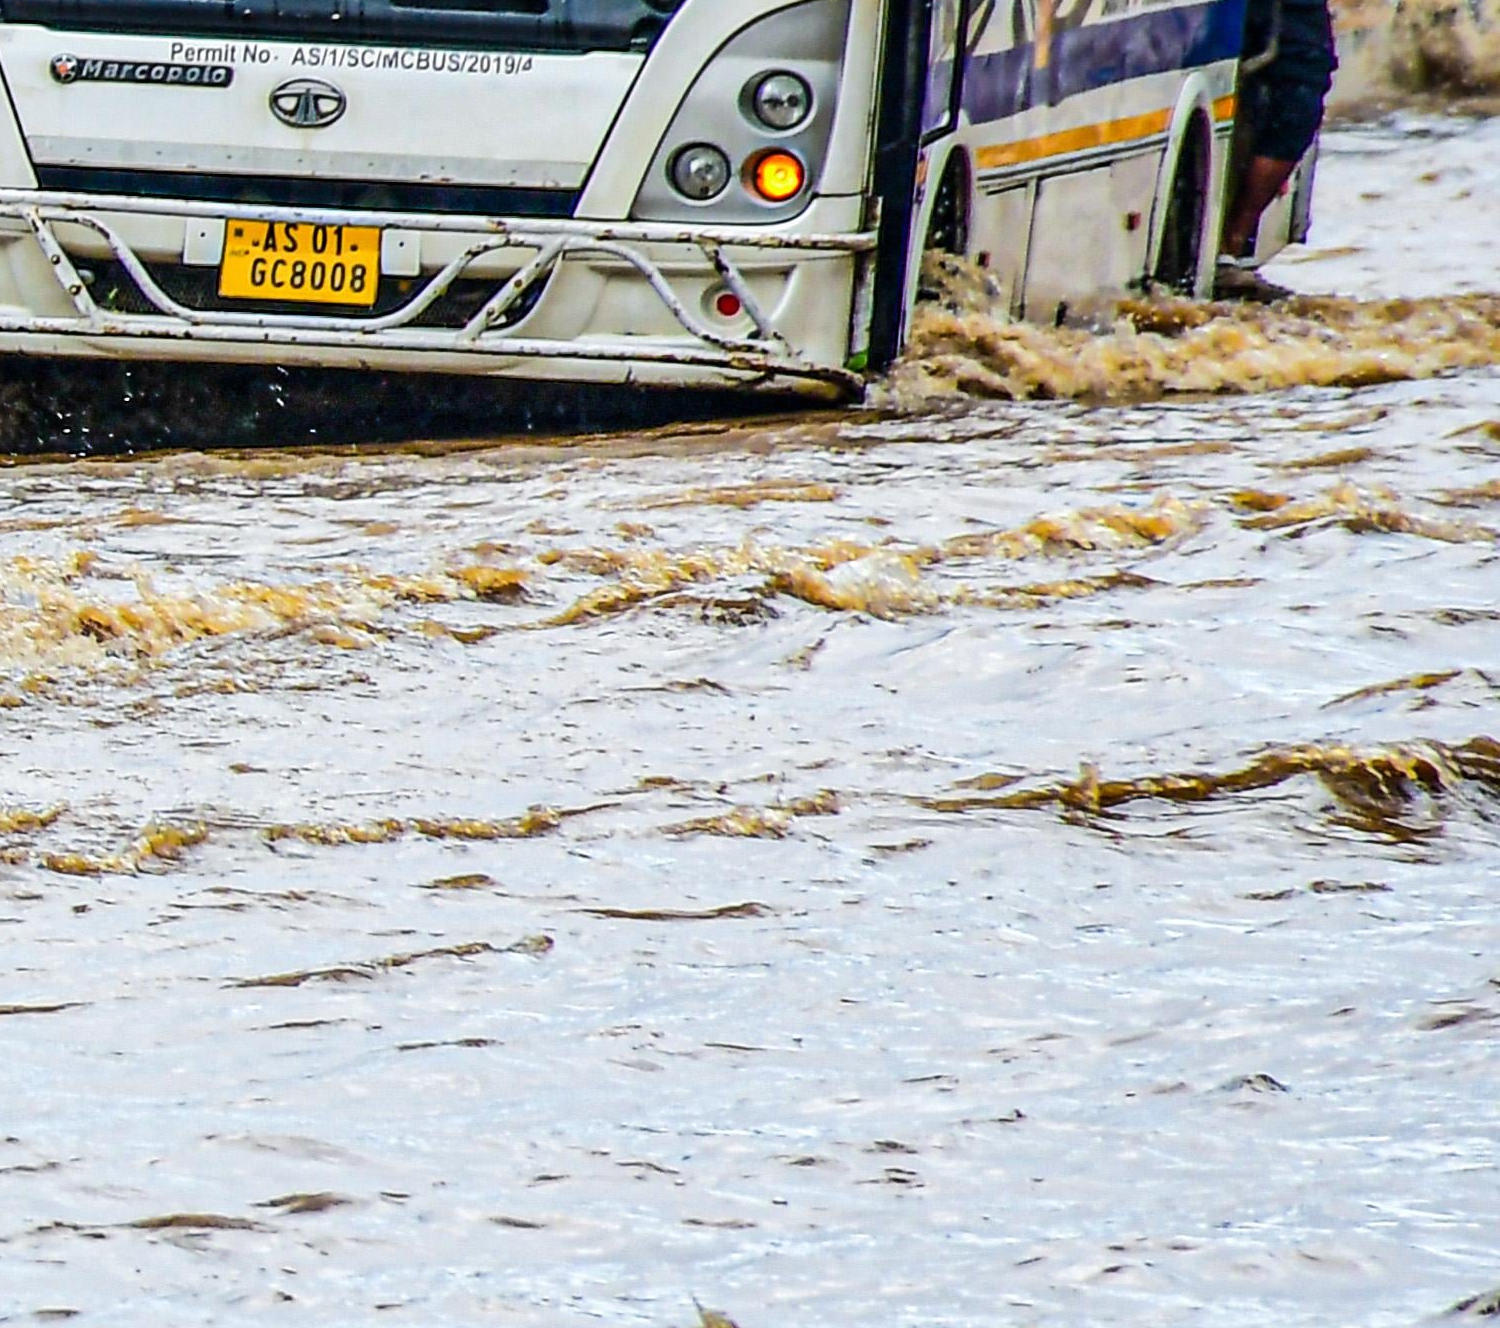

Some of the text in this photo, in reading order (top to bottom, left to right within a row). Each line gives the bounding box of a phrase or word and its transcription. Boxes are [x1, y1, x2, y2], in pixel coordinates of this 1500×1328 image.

[169, 41, 237, 64] Permit
[82, 58, 229, 84] Marcopolo
[263, 221, 344, 256] AS 01
[251, 257, 366, 293] GC8008
